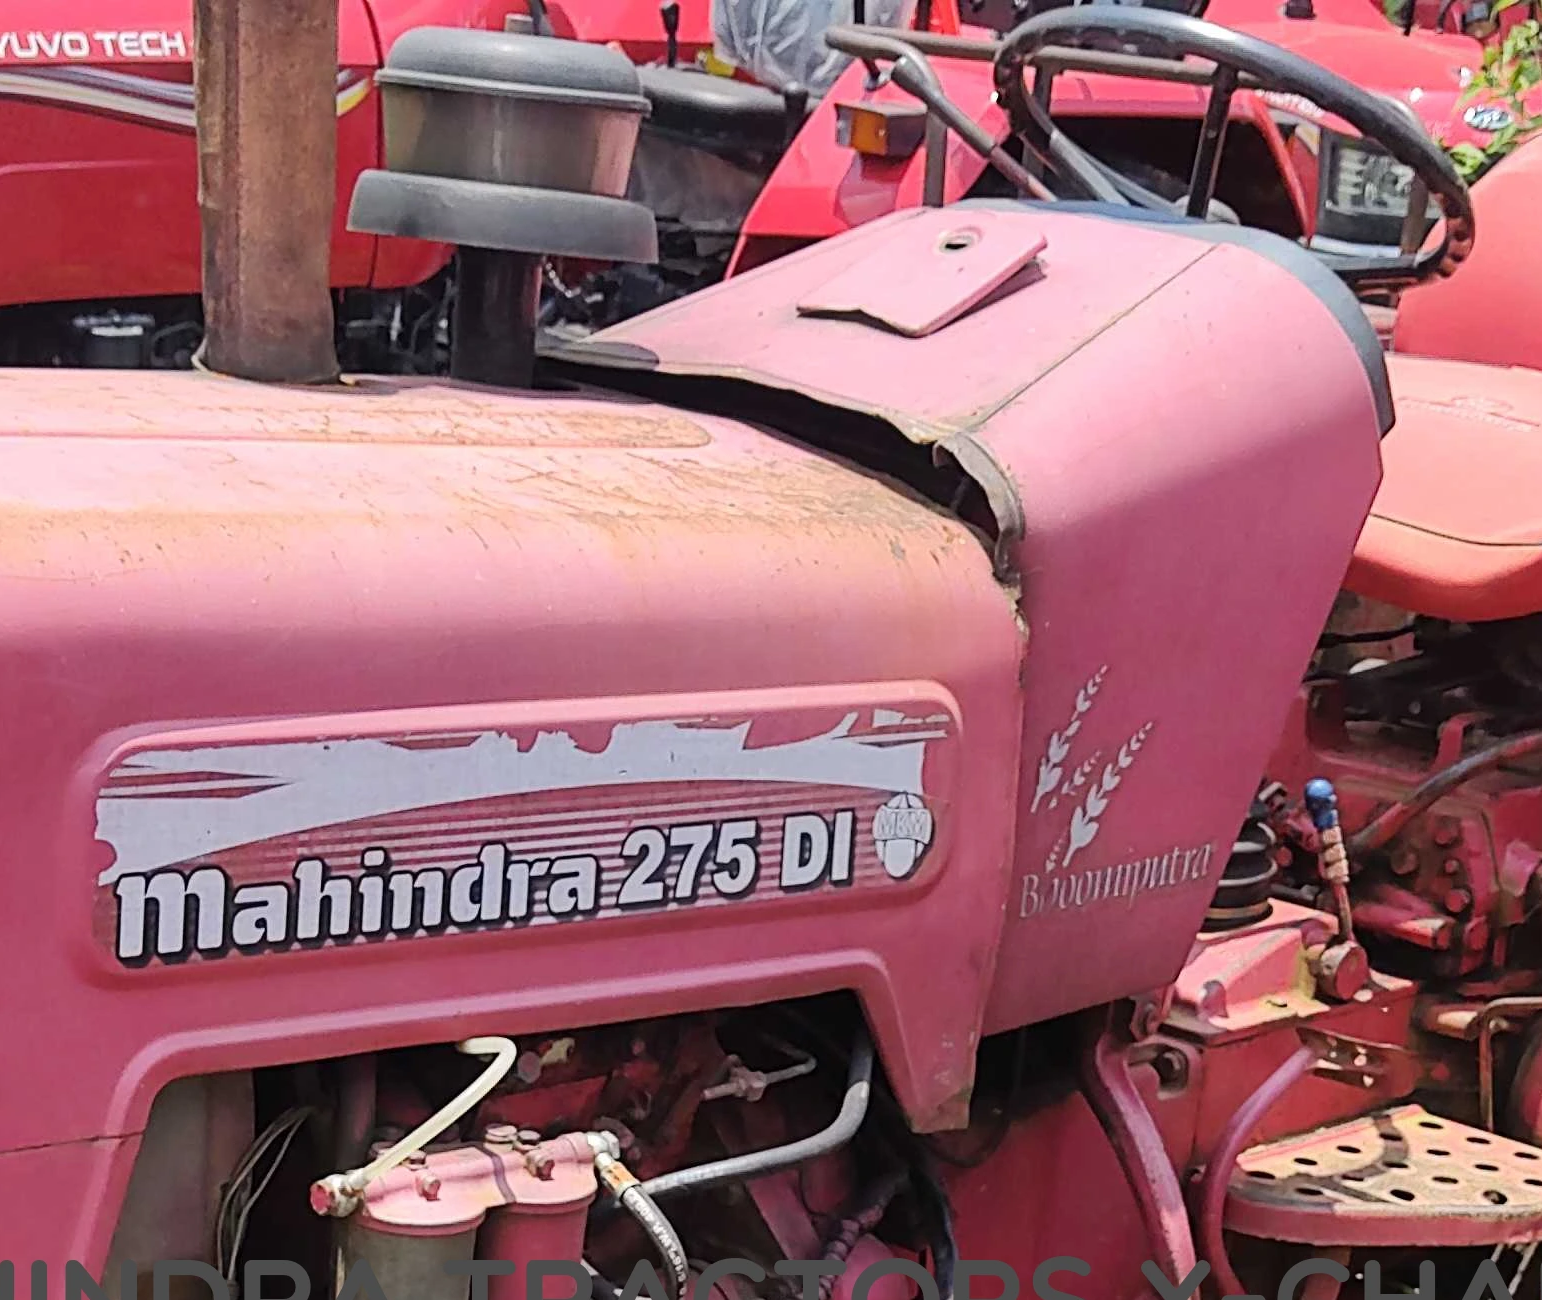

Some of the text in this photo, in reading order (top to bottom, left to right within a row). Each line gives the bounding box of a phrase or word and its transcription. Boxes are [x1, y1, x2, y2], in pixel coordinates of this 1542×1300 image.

[94, 31, 186, 57] TECH
[116, 810, 856, 967] Mahindra 275 DI
